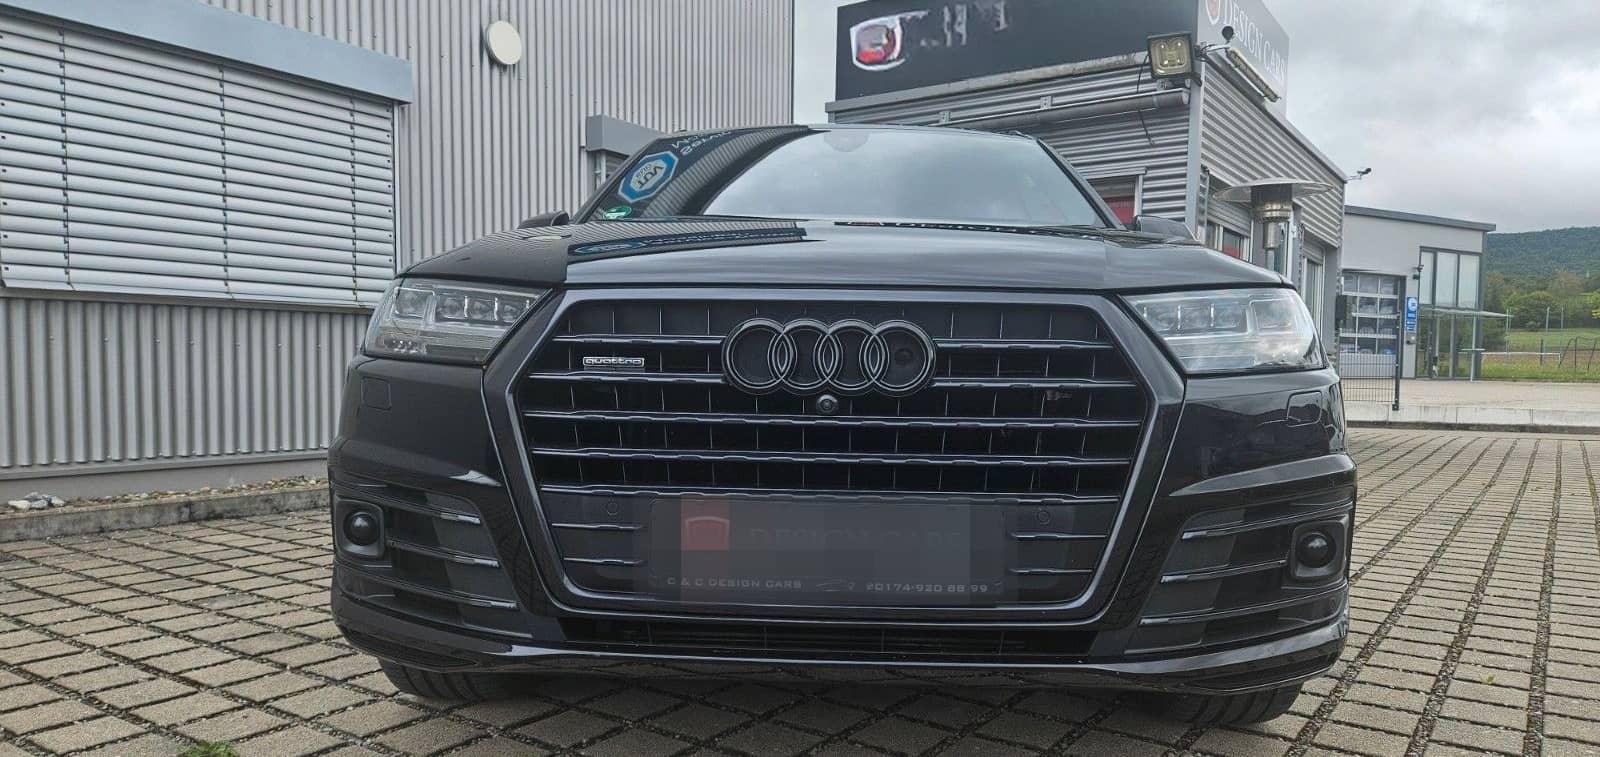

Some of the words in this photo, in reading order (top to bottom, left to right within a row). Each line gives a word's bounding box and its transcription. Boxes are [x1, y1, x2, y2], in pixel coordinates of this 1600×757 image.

[584, 357, 644, 367] quattro
[708, 578, 760, 588] DESIGN
[765, 579, 802, 589] CARS
[970, 584, 988, 593] 99
